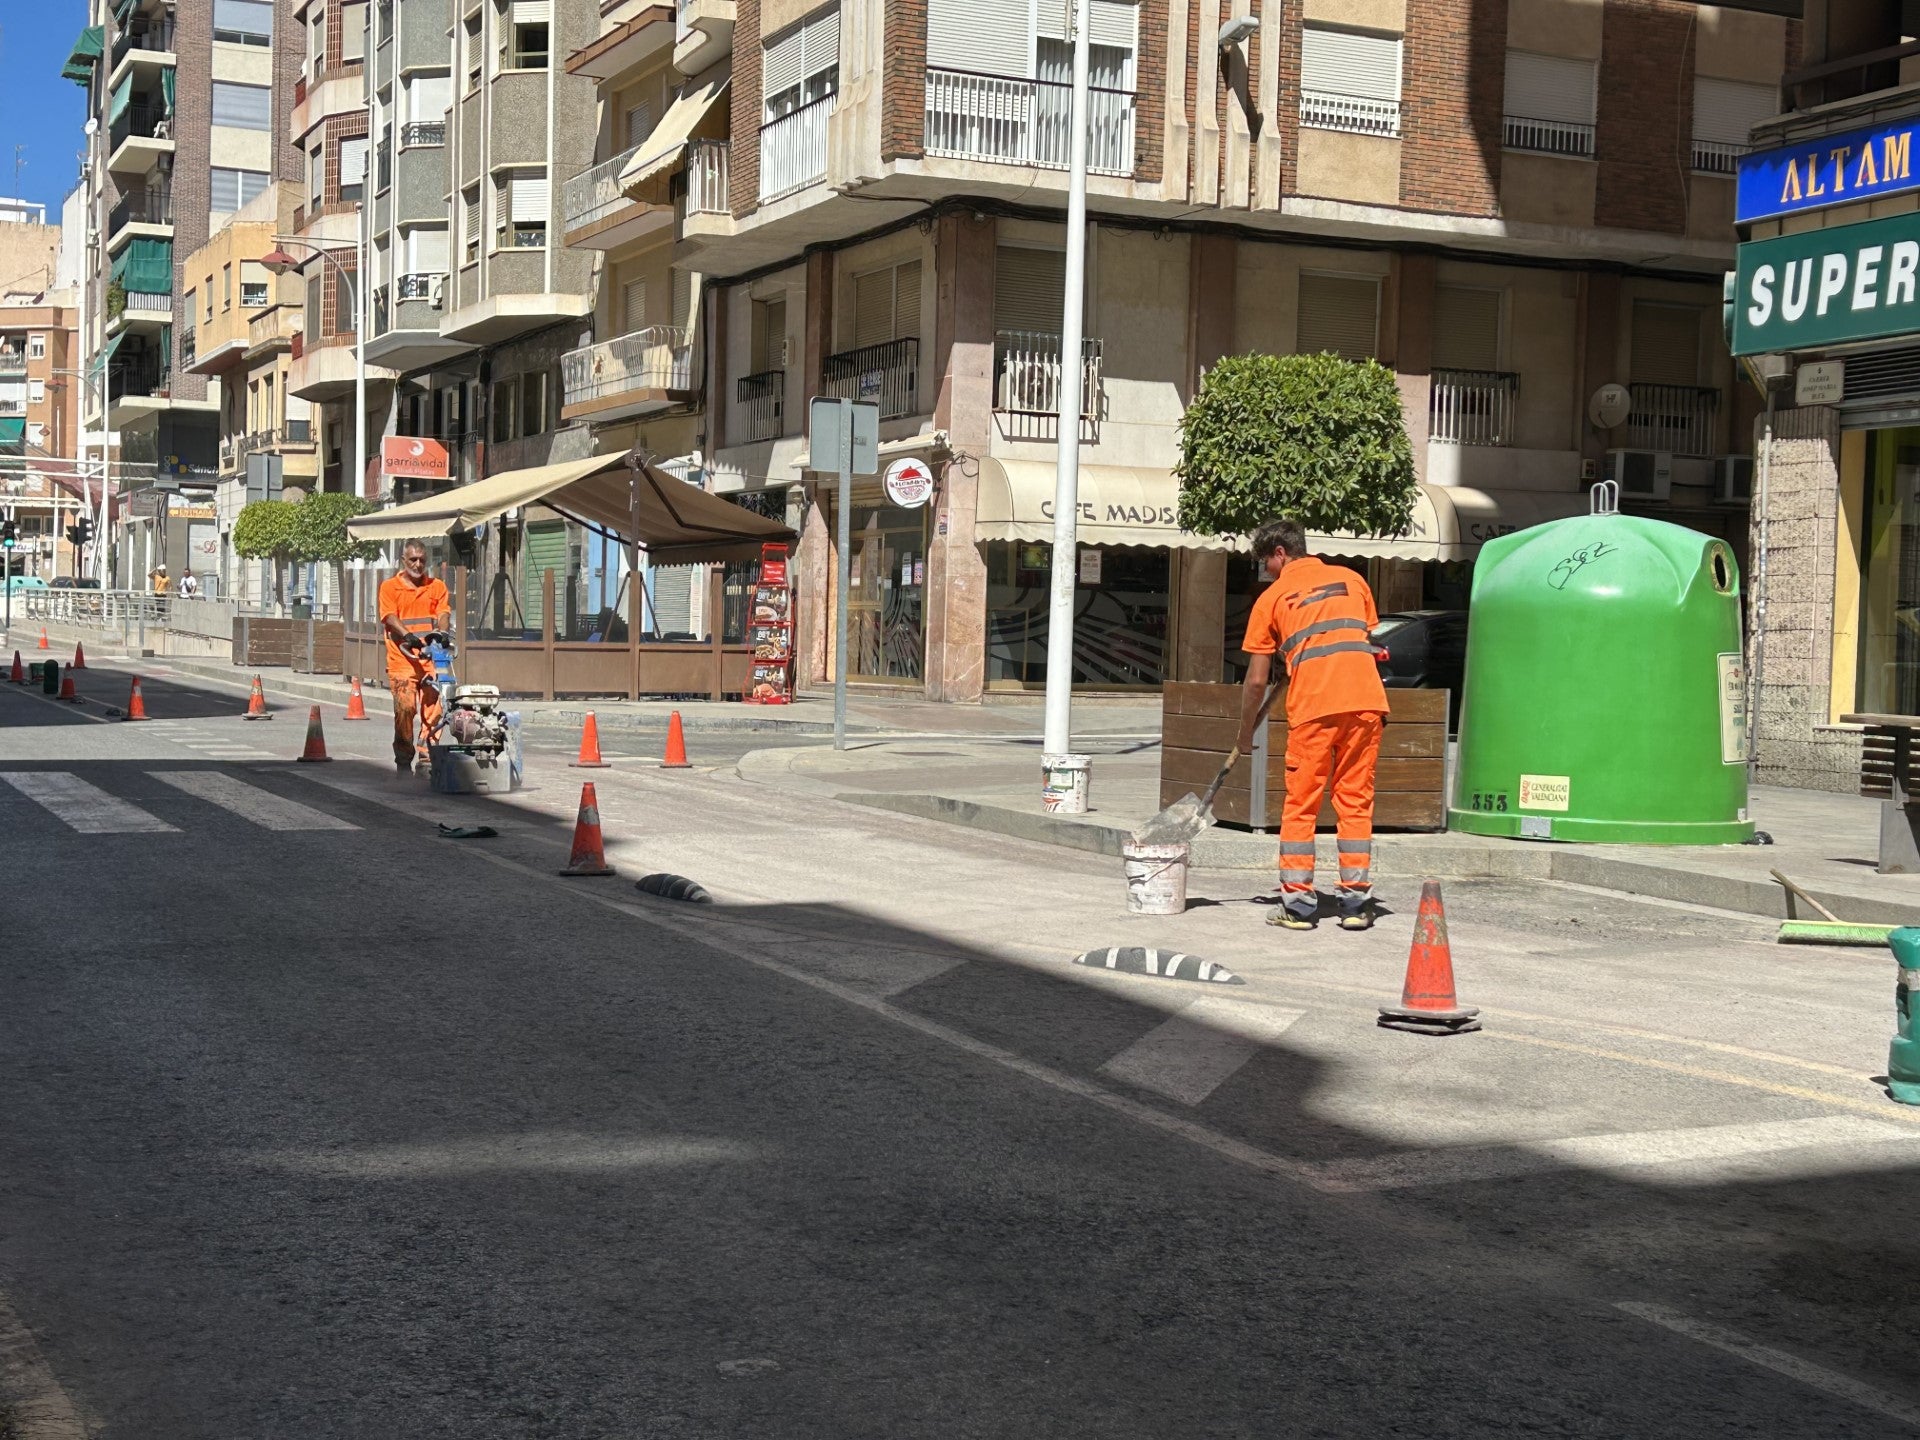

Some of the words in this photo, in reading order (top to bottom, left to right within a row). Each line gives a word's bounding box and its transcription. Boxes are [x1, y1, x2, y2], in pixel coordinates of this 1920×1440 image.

[1780, 131, 1912, 203] ALTAM
[1748, 240, 1920, 328] SUPER
[1041, 500, 1097, 521] CFE
[1531, 782, 1568, 793] GENERALITAT
[1531, 792, 1567, 803] VALENCIANA
[1472, 793, 1508, 812] 353
